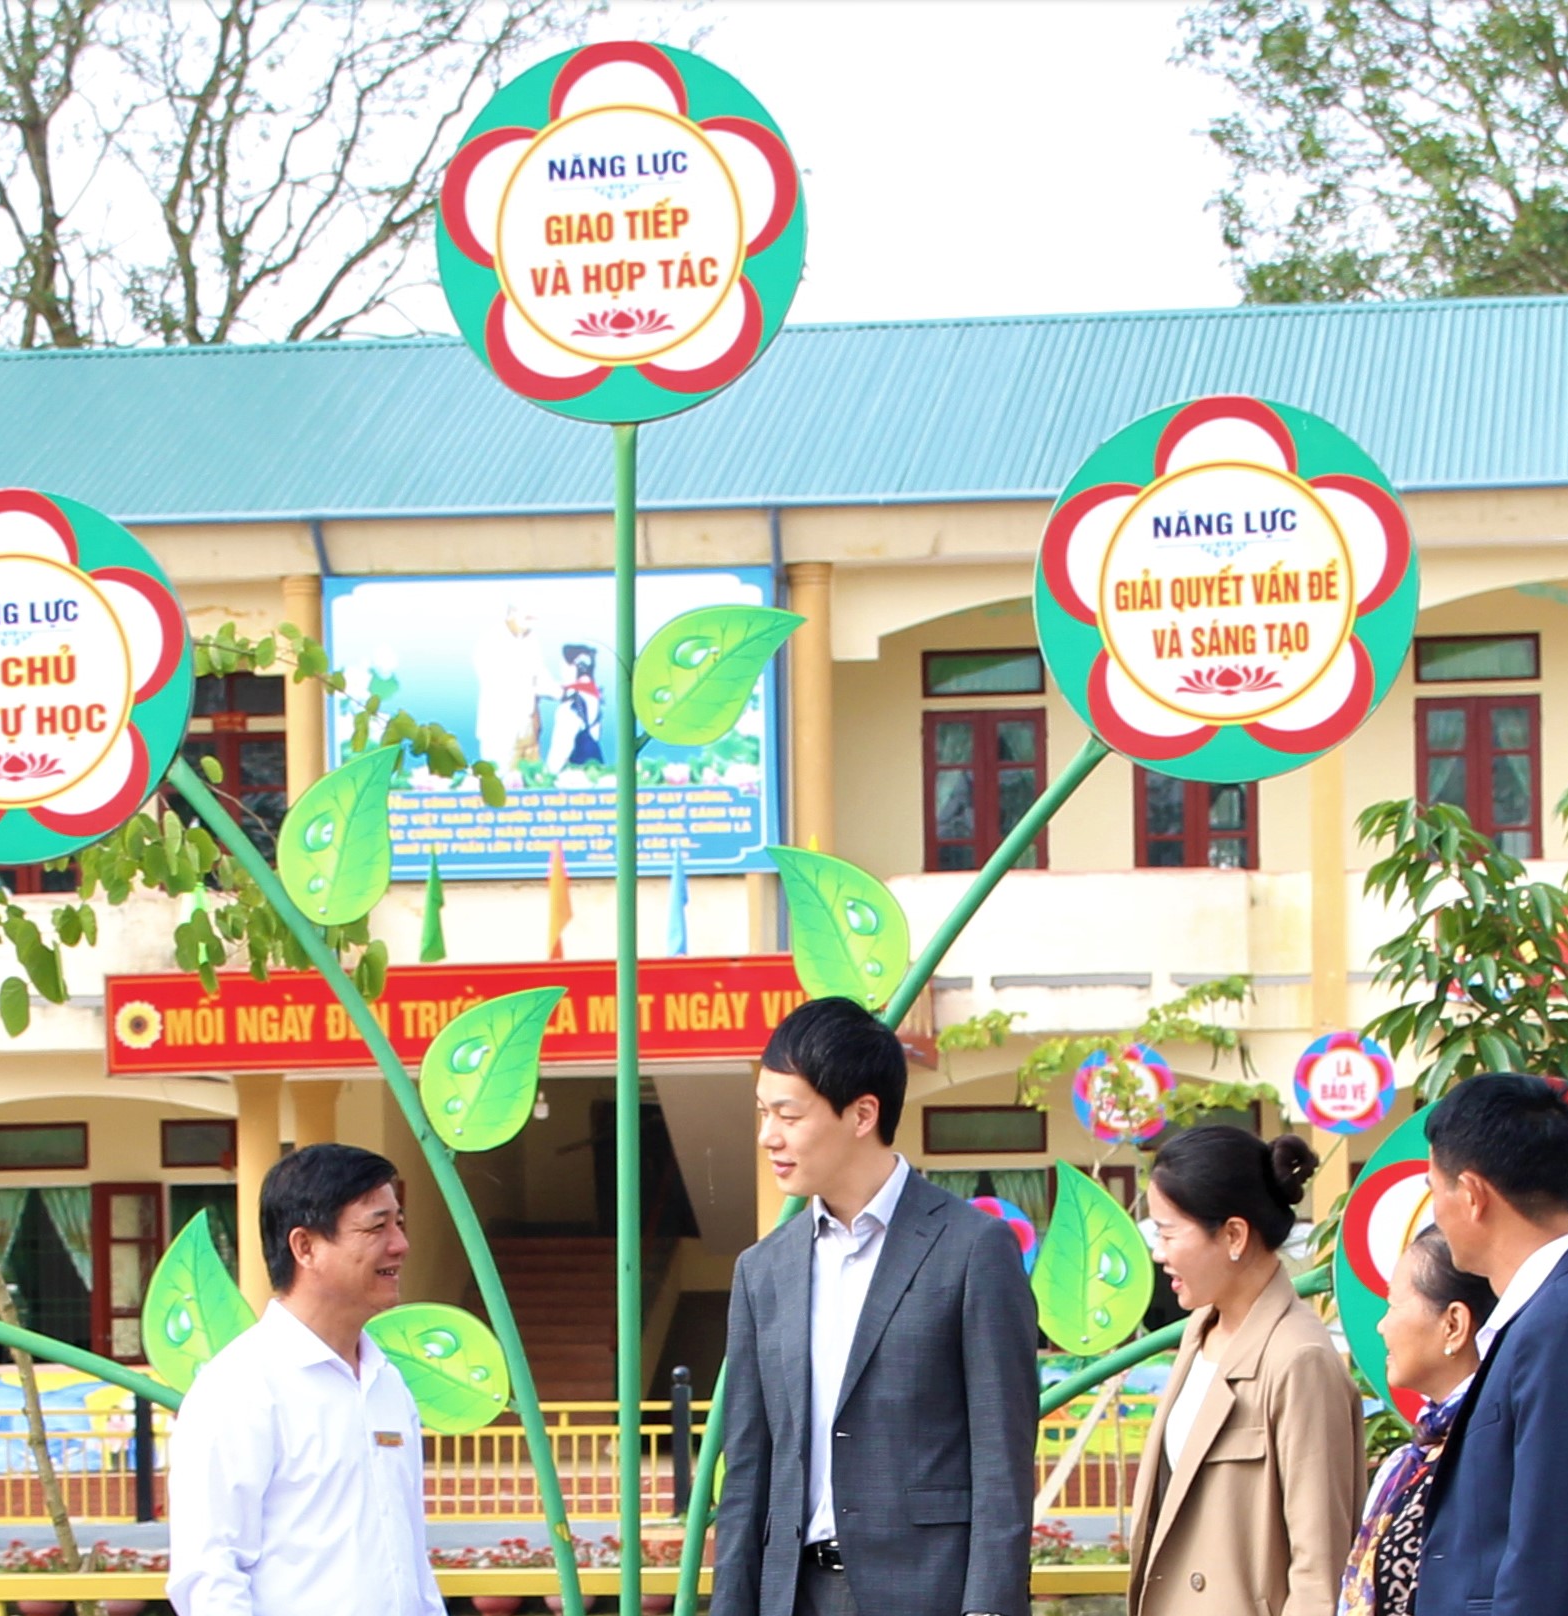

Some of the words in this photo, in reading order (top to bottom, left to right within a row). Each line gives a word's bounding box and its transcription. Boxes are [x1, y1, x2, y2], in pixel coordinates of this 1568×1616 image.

[548, 153, 626, 181] NĂNG
[637, 150, 688, 180] LỰC
[544, 212, 614, 246] GIAO
[624, 197, 690, 241] TIẾP
[530, 260, 571, 297] VÀ
[583, 258, 647, 300] HỢP
[657, 251, 719, 289] TÁC
[1153, 510, 1233, 539] NĂNG
[1244, 508, 1298, 539] LỰC
[1114, 568, 1162, 612] GIẢI
[1170, 564, 1244, 613] QUYẾT
[1251, 560, 1301, 604] VẤN
[30, 599, 79, 628] LỰC
[1152, 621, 1184, 660] VÀ
[1191, 619, 1257, 658] SÁNG
[1265, 621, 1310, 661] TẠO
[0, 644, 77, 687] CHỦ
[36, 703, 107, 741] HỌC
[164, 994, 225, 1046] MỖI
[236, 994, 315, 1043] NGÀY
[325, 1001, 391, 1041] ĐN
[587, 995, 654, 1033] MT
[665, 981, 749, 1031] NGÀY
